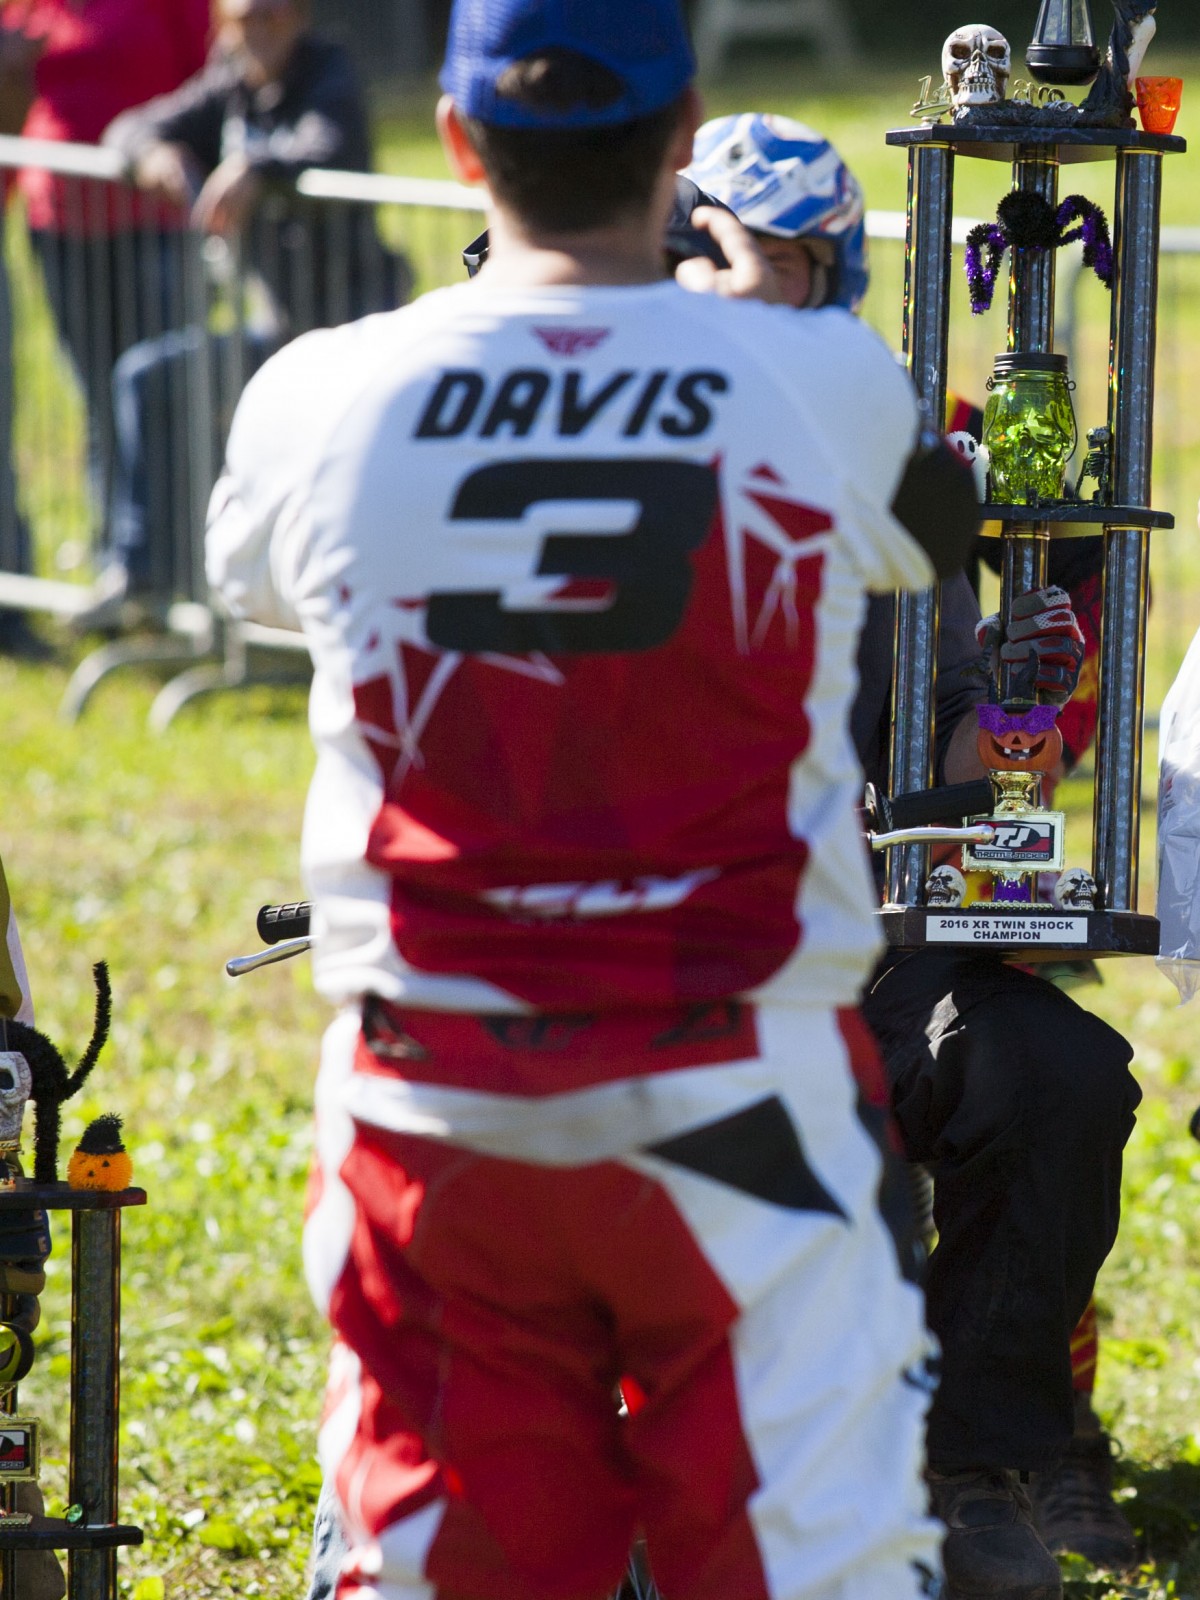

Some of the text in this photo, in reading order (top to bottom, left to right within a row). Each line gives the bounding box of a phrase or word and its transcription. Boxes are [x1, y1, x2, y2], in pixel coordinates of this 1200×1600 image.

[414, 369, 731, 441] DAVIS
[426, 459, 720, 654] 3
[995, 827, 1031, 847] TJ
[975, 850, 1013, 859] THROTTLE
[940, 919, 1074, 931] 2016 XR TWIN SHOCK
[973, 930, 1041, 940] CHAMPION
